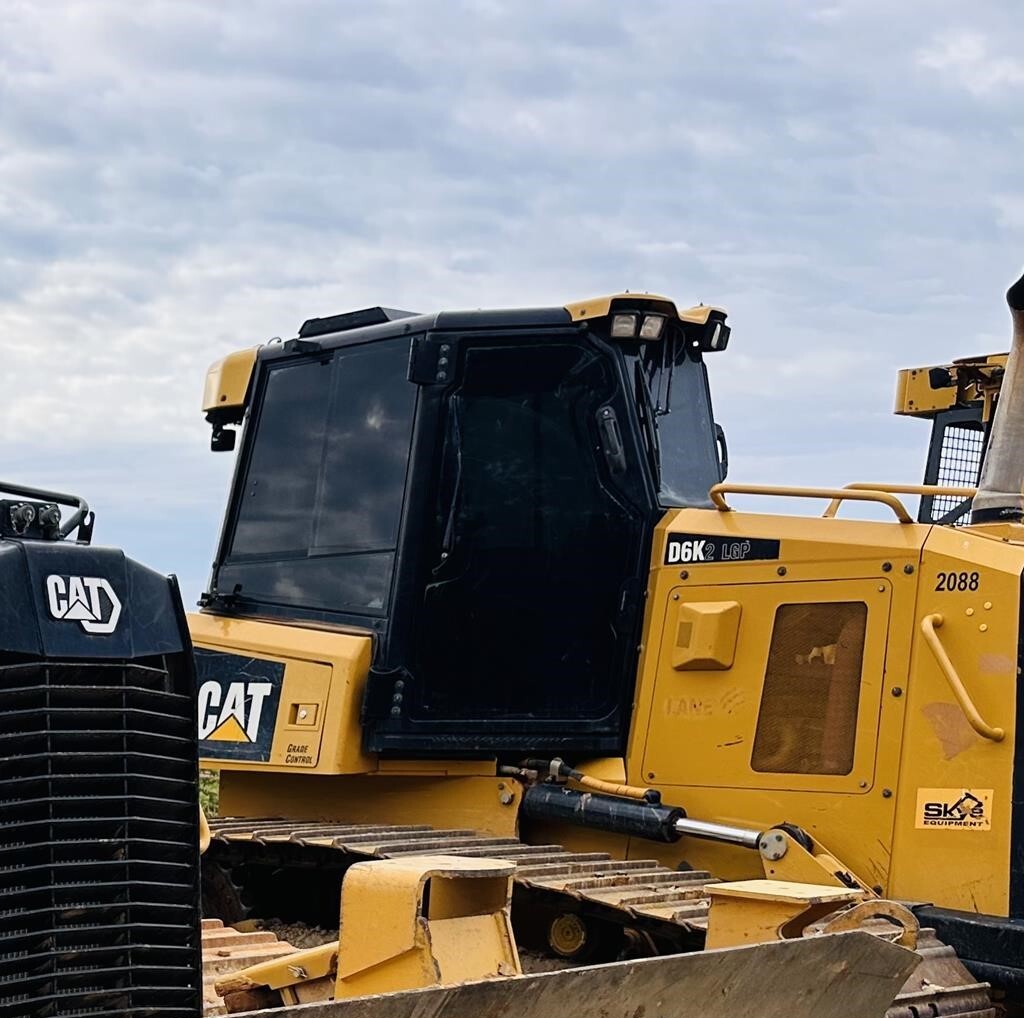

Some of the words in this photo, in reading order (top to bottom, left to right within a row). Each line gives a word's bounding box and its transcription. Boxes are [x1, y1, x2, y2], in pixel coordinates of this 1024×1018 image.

[721, 542, 751, 560] LGP
[46, 574, 102, 621] CAT
[935, 572, 979, 592] 2088
[198, 680, 273, 743] CAT
